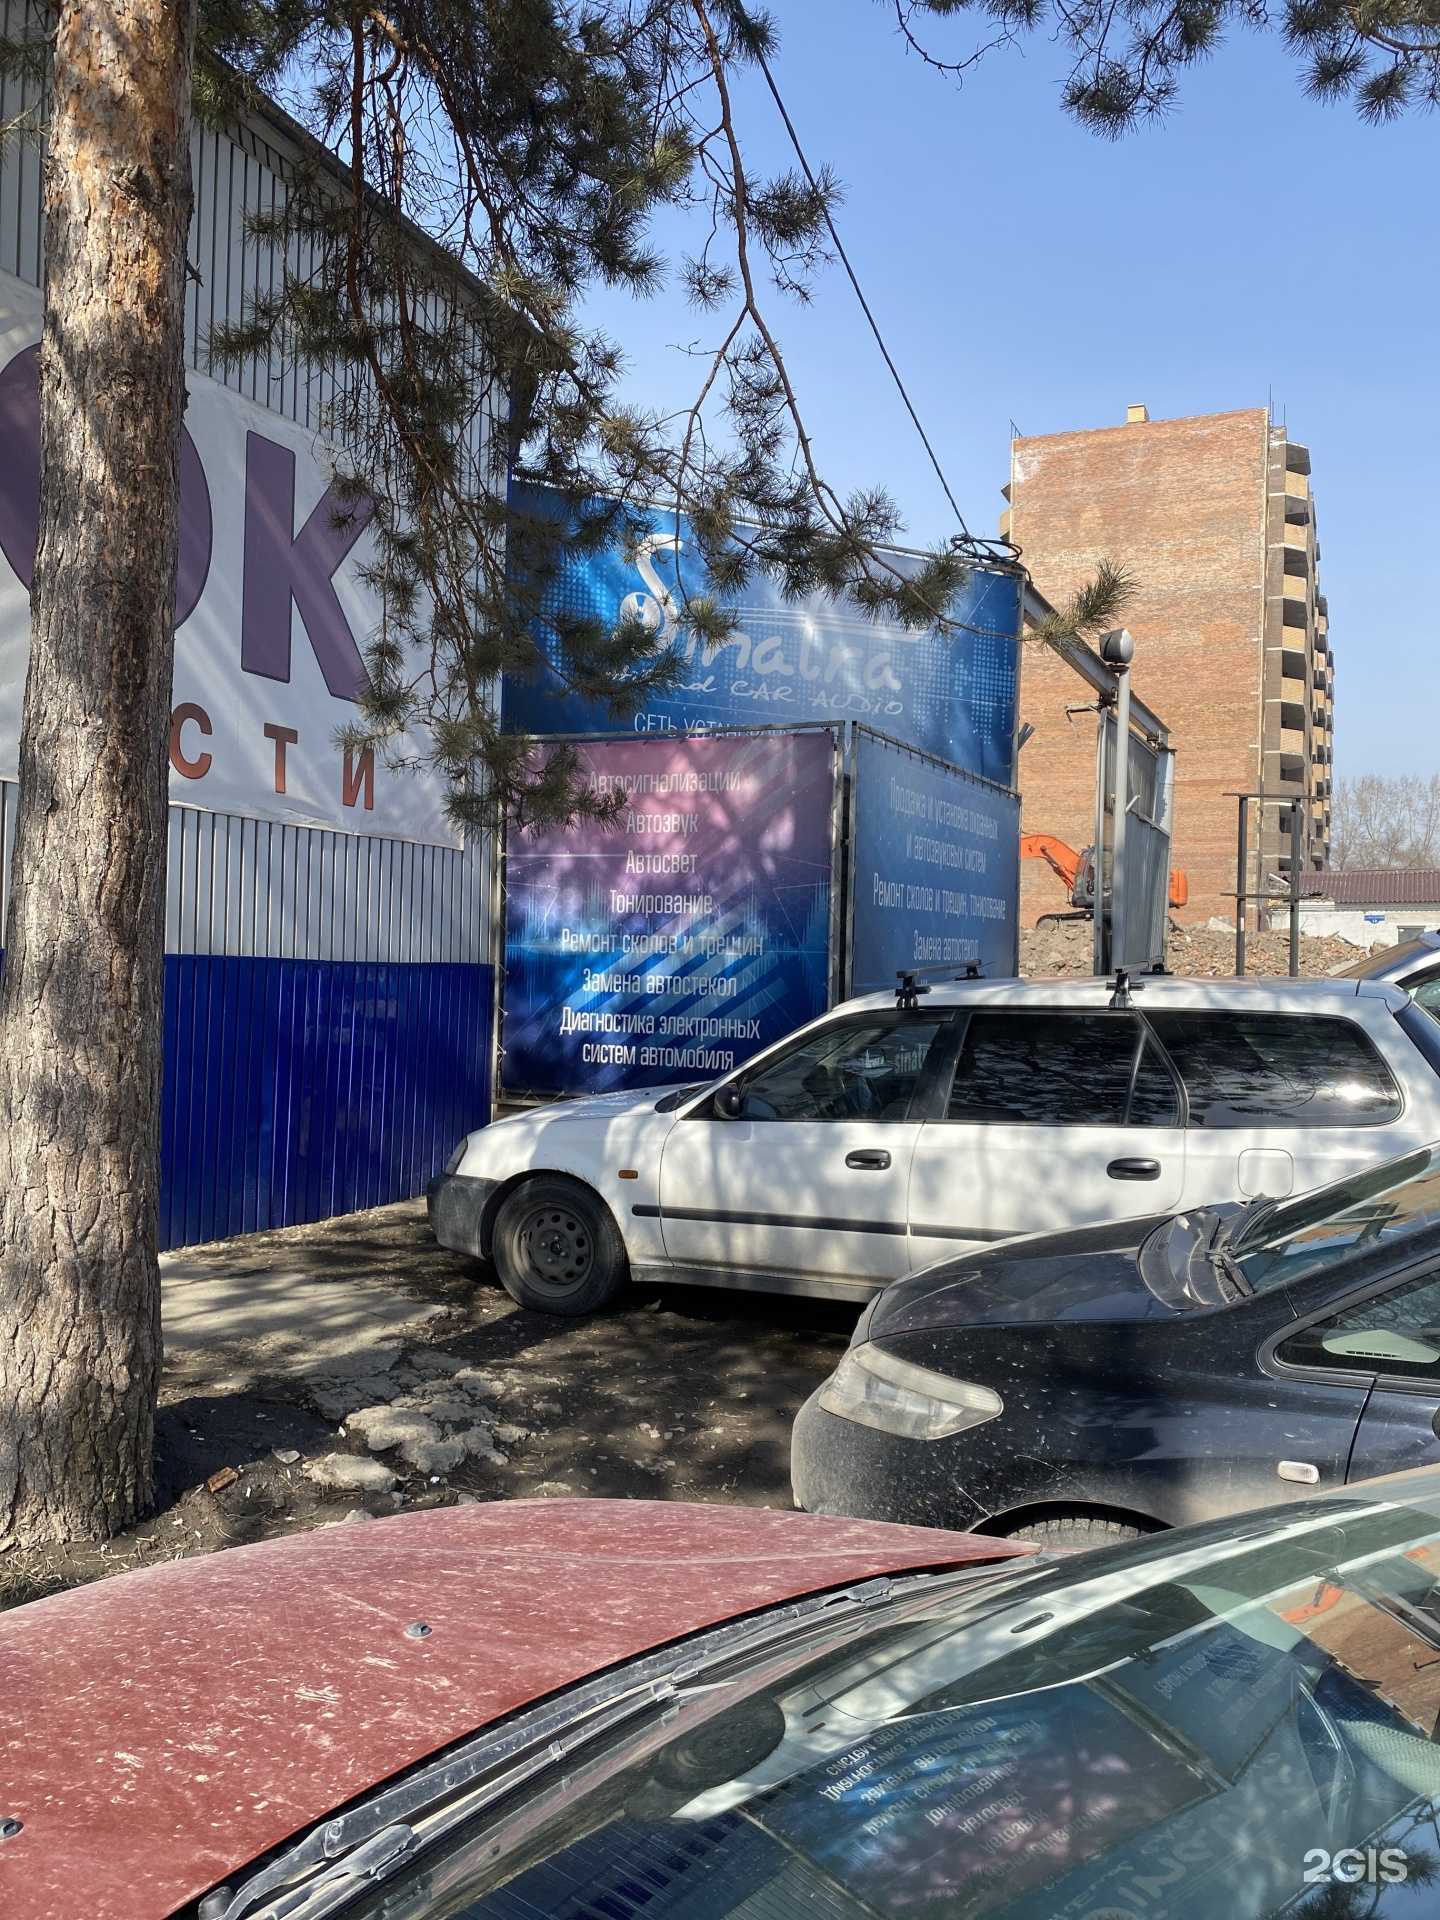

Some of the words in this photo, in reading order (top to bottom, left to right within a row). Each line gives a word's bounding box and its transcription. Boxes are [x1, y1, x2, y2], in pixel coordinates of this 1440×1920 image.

[730, 680, 796, 702] CAR
[589, 771, 741, 793] Автосигнализации
[626, 812, 699, 836] Автозвук
[625, 850, 698, 874] Автосвет
[610, 890, 713, 916] Тонирование
[873, 872, 905, 908] Ремонт
[906, 883, 934, 912] сколов
[561, 929, 617, 953] Ремонт
[622, 933, 676, 955] сколов
[683, 936, 695, 955] и
[700, 935, 763, 957] трещин
[913, 929, 942, 961] Замена
[582, 968, 641, 994] Замена
[646, 974, 737, 998] автостекол
[560, 1007, 655, 1035] Диагностика
[659, 1015, 761, 1040] электронных
[582, 1042, 636, 1065] систем
[640, 1044, 734, 1071] автомобиля
